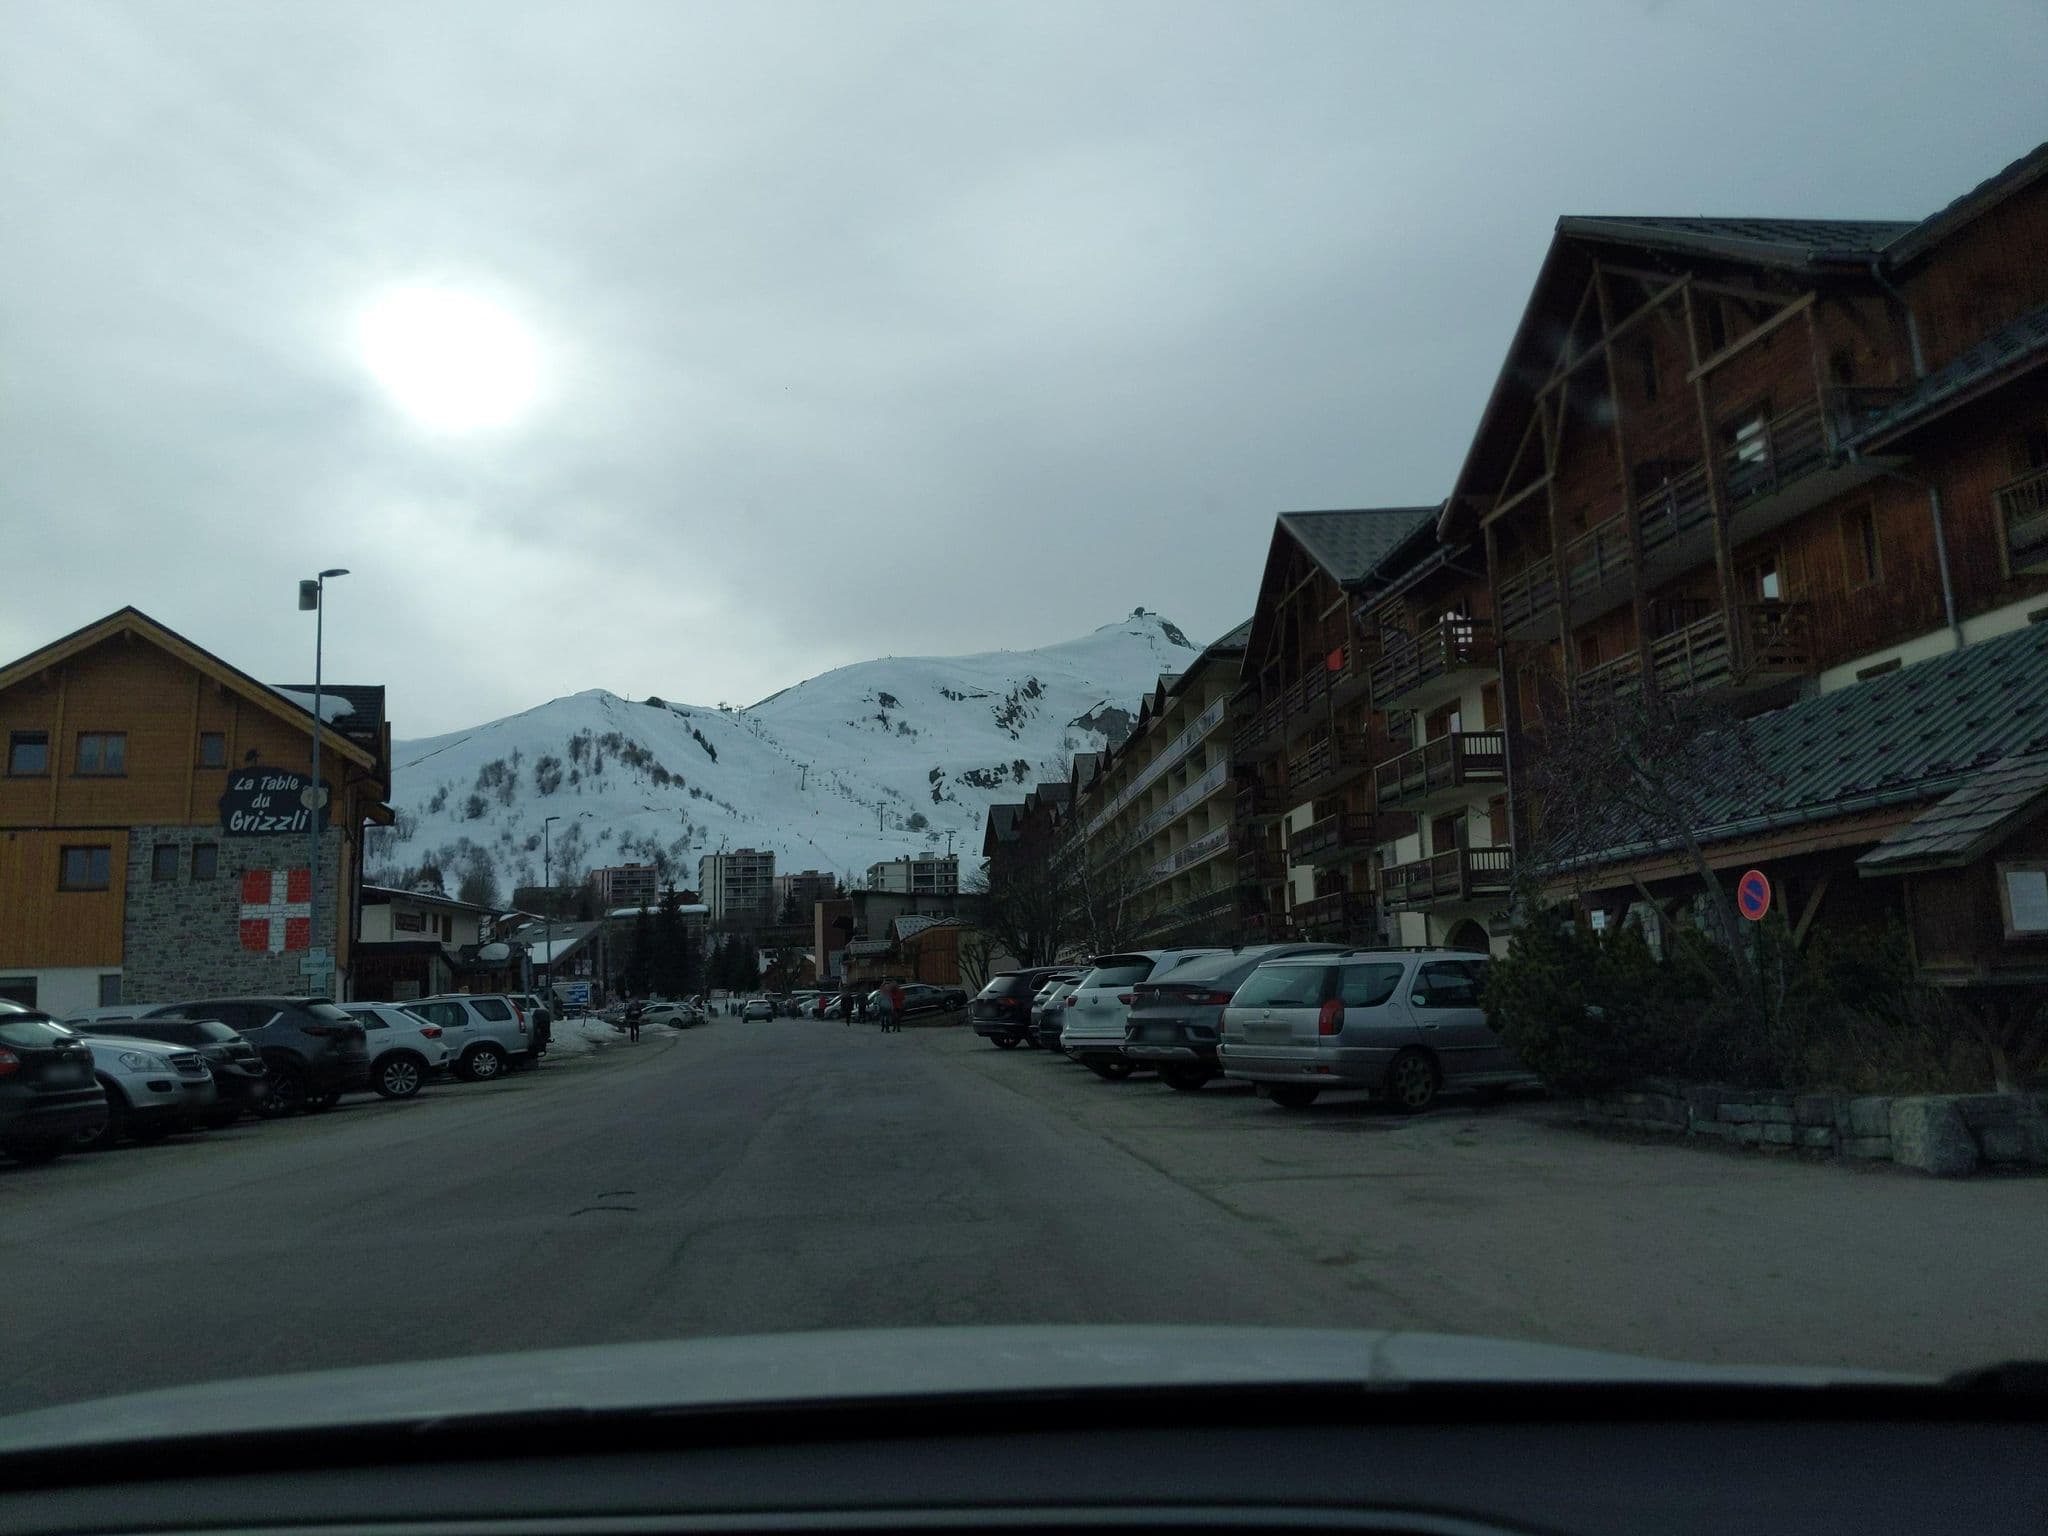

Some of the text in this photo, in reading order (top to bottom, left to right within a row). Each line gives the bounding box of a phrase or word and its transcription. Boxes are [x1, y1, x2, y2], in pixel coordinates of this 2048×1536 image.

[234, 775, 299, 791] La Table
[251, 793, 271, 808] du
[230, 809, 310, 832] Grizzli
